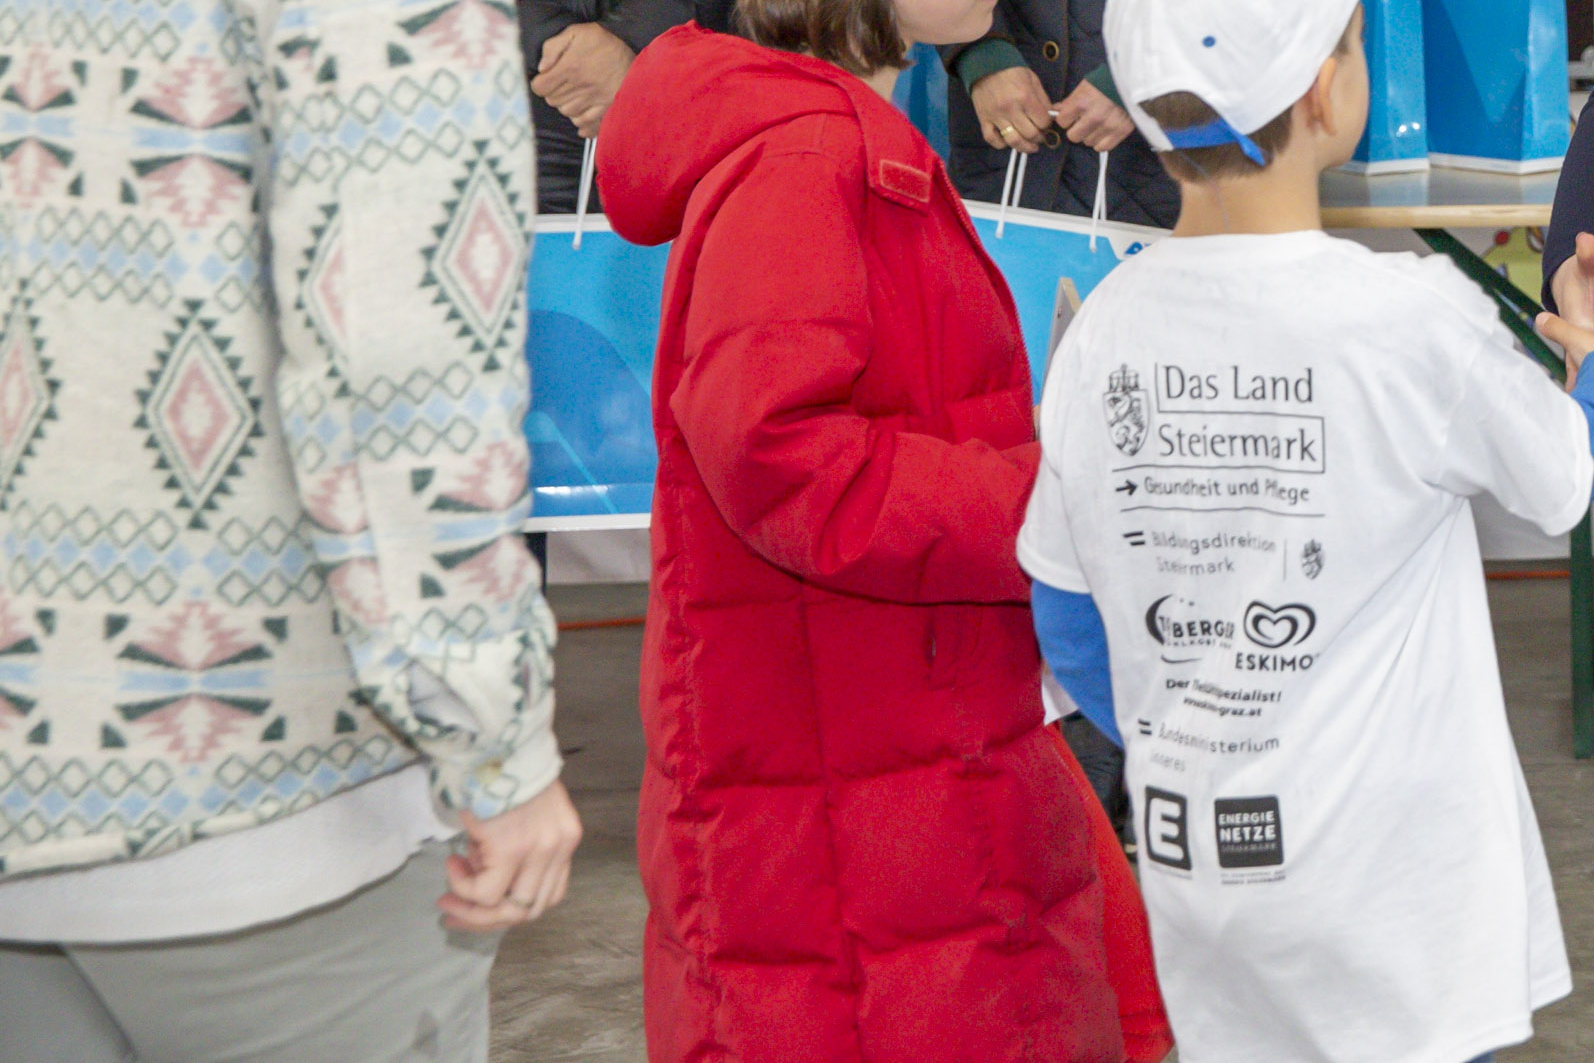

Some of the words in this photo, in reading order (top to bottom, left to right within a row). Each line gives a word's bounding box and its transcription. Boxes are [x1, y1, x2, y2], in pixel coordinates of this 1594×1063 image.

[1163, 365, 1219, 400] Das
[1233, 366, 1314, 403] Land
[1158, 423, 1317, 463] Steiermark
[1228, 478, 1260, 497] und
[1234, 653, 1315, 673] ESKIMO
[1165, 679, 1191, 690] Der
[1218, 810, 1276, 826] ENERGIE
[1218, 825, 1277, 843] NETZE
